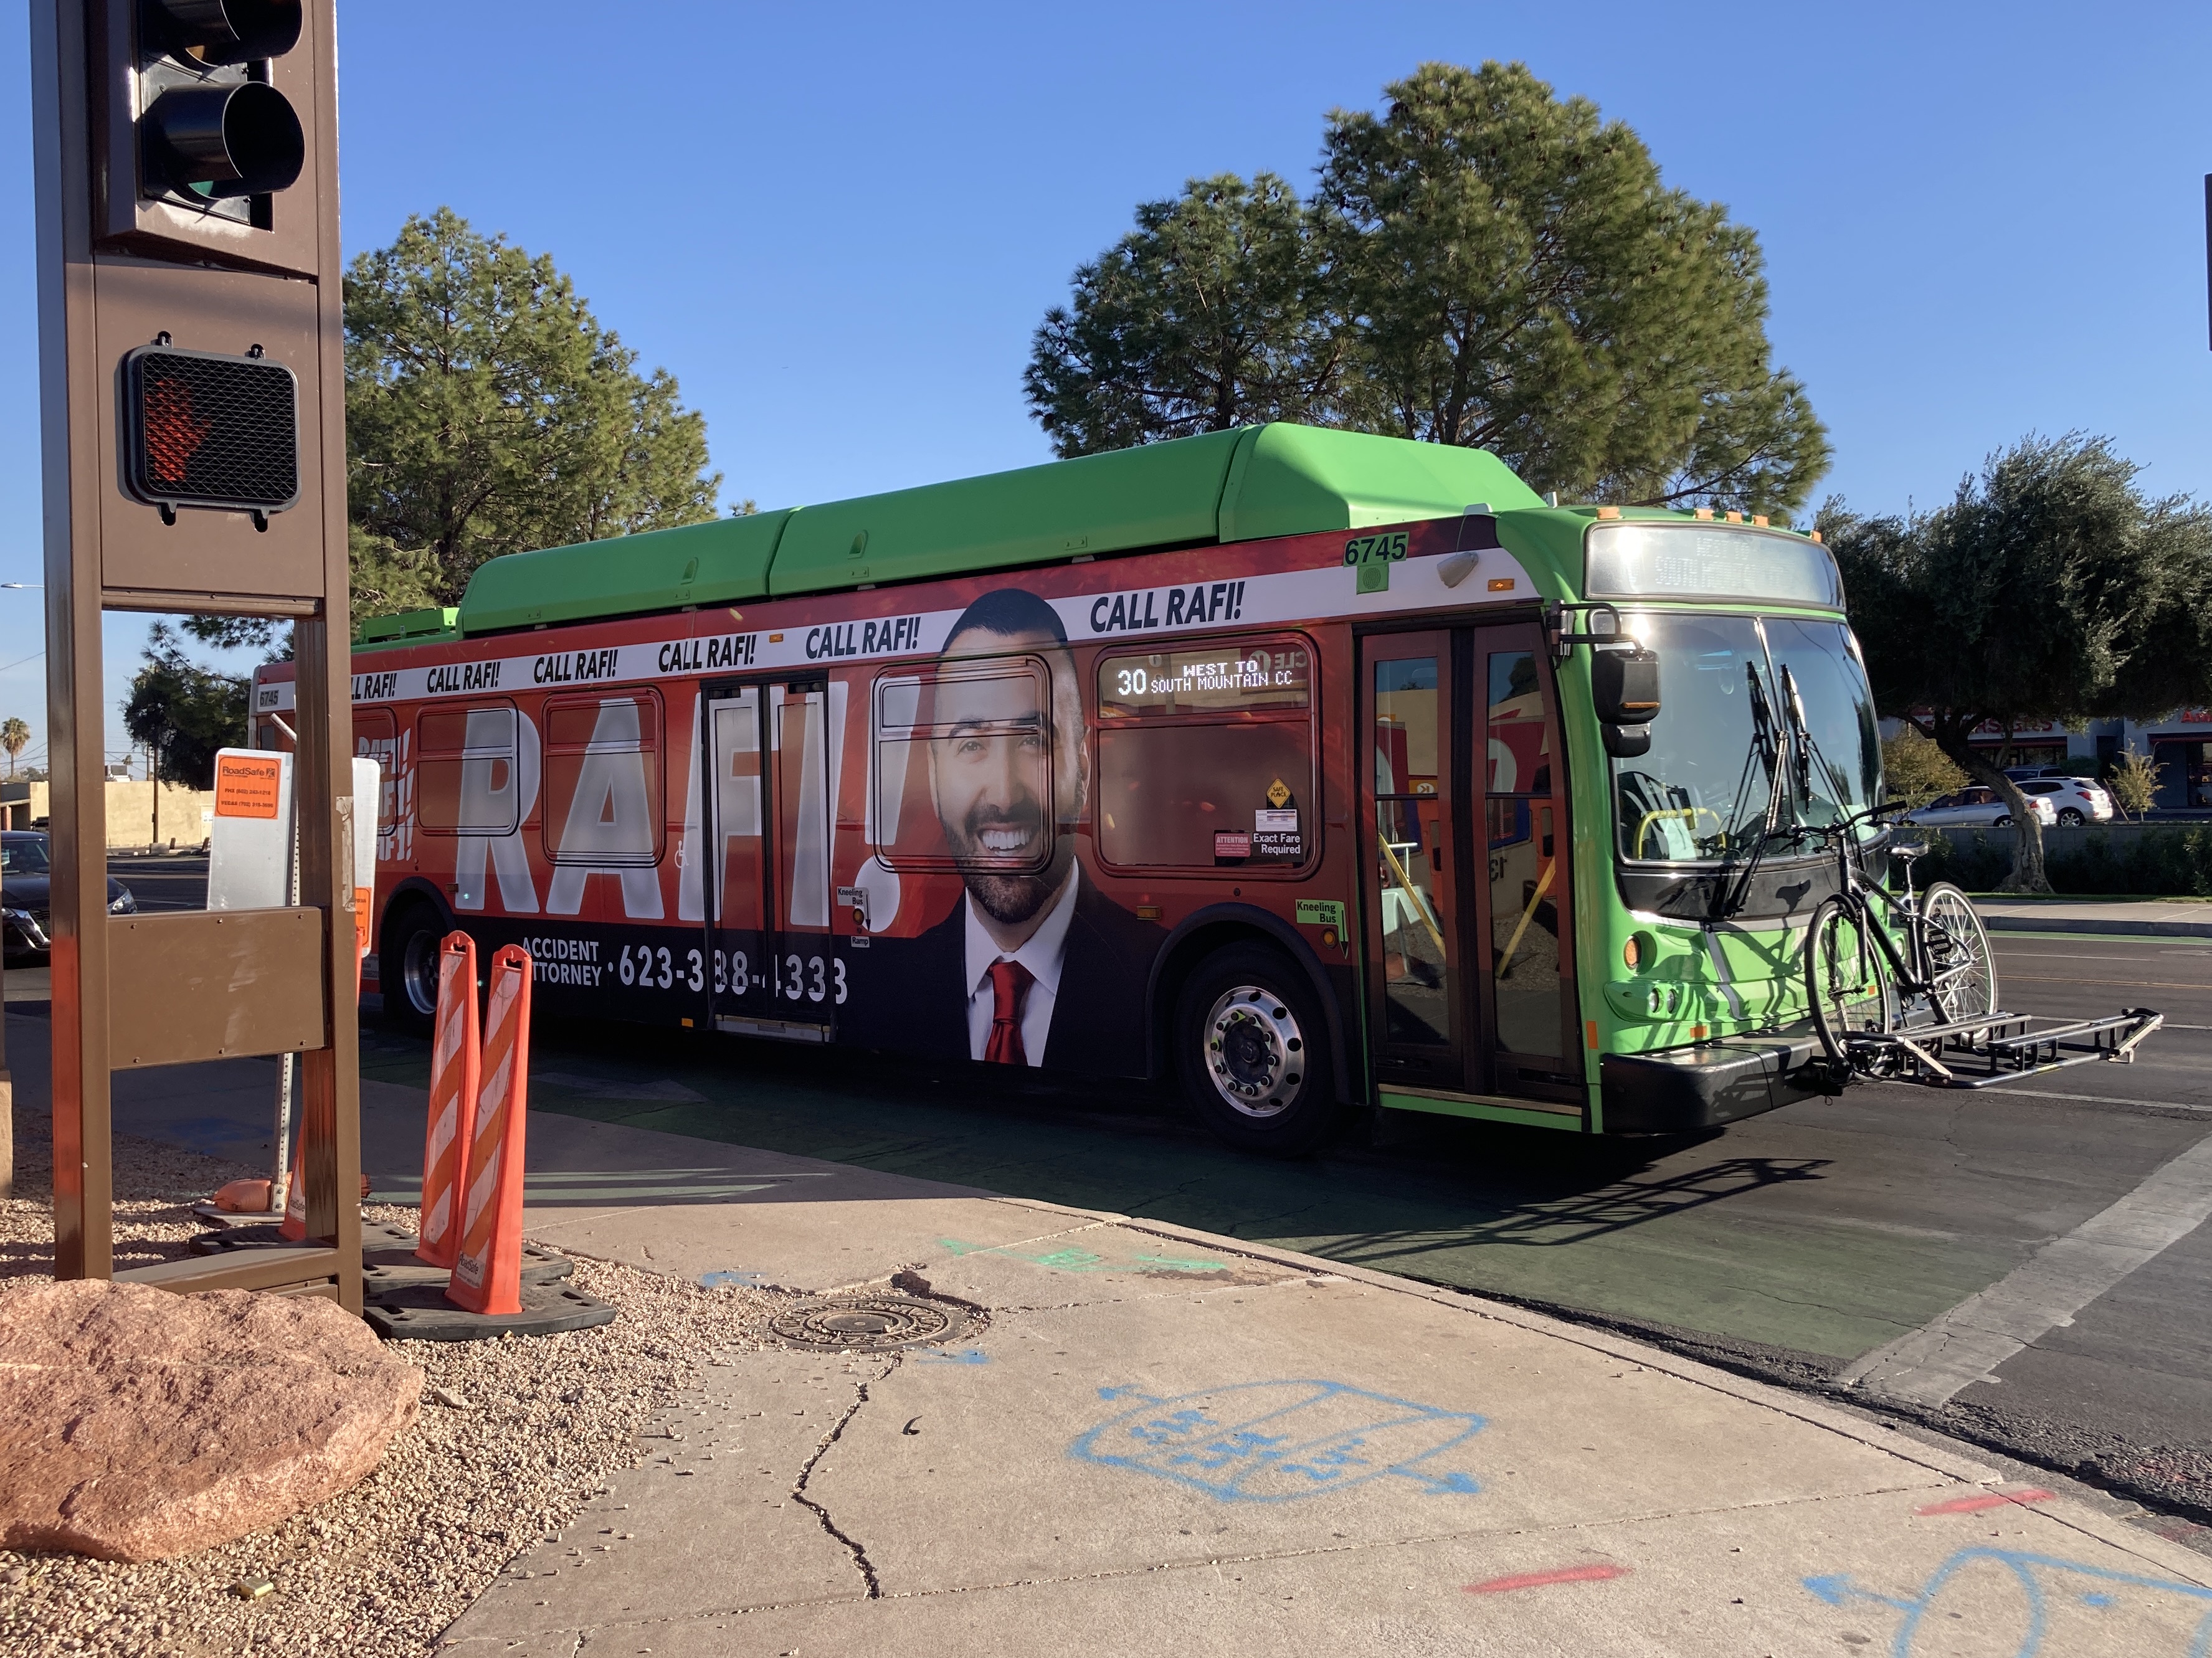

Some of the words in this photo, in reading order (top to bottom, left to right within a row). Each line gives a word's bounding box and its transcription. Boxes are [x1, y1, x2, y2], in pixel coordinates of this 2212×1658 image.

[1345, 534, 1407, 565] 6745
[1090, 592, 1159, 633] CALL
[1165, 581, 1245, 626] RAFI!
[806, 624, 857, 659] CALL
[862, 617, 921, 653] RAFI!
[658, 640, 702, 673] CALL
[707, 634, 757, 667] RAFI!
[427, 666, 460, 693] CALL
[463, 661, 501, 690] RAFI!
[534, 655, 571, 683] CALL
[575, 650, 619, 680] RAFI!
[1183, 662, 1228, 678] WEST
[1235, 660, 1258, 673] TO
[351, 677, 361, 701] LL
[364, 673, 397, 699] RAFI!
[1118, 668, 1147, 696] 30
[1151, 678, 1191, 694] SOUTH
[1197, 672, 1268, 691] MOUNTAIN
[1275, 670, 1293, 685] CC
[260, 689, 279, 706] 6745
[222, 766, 264, 776] RoadSafe
[1253, 833, 1278, 843] Exact
[1280, 833, 1301, 843] Fare
[1261, 844, 1301, 856] Required
[838, 888, 863, 898] Kneeling
[852, 897, 863, 905] Bus
[1297, 901, 1336, 914] Kneeling
[1319, 913, 1336, 923] Bus
[522, 937, 599, 962] ACCIDENT
[852, 937, 868, 946] Ramp
[532, 962, 602, 987] TTORNEY
